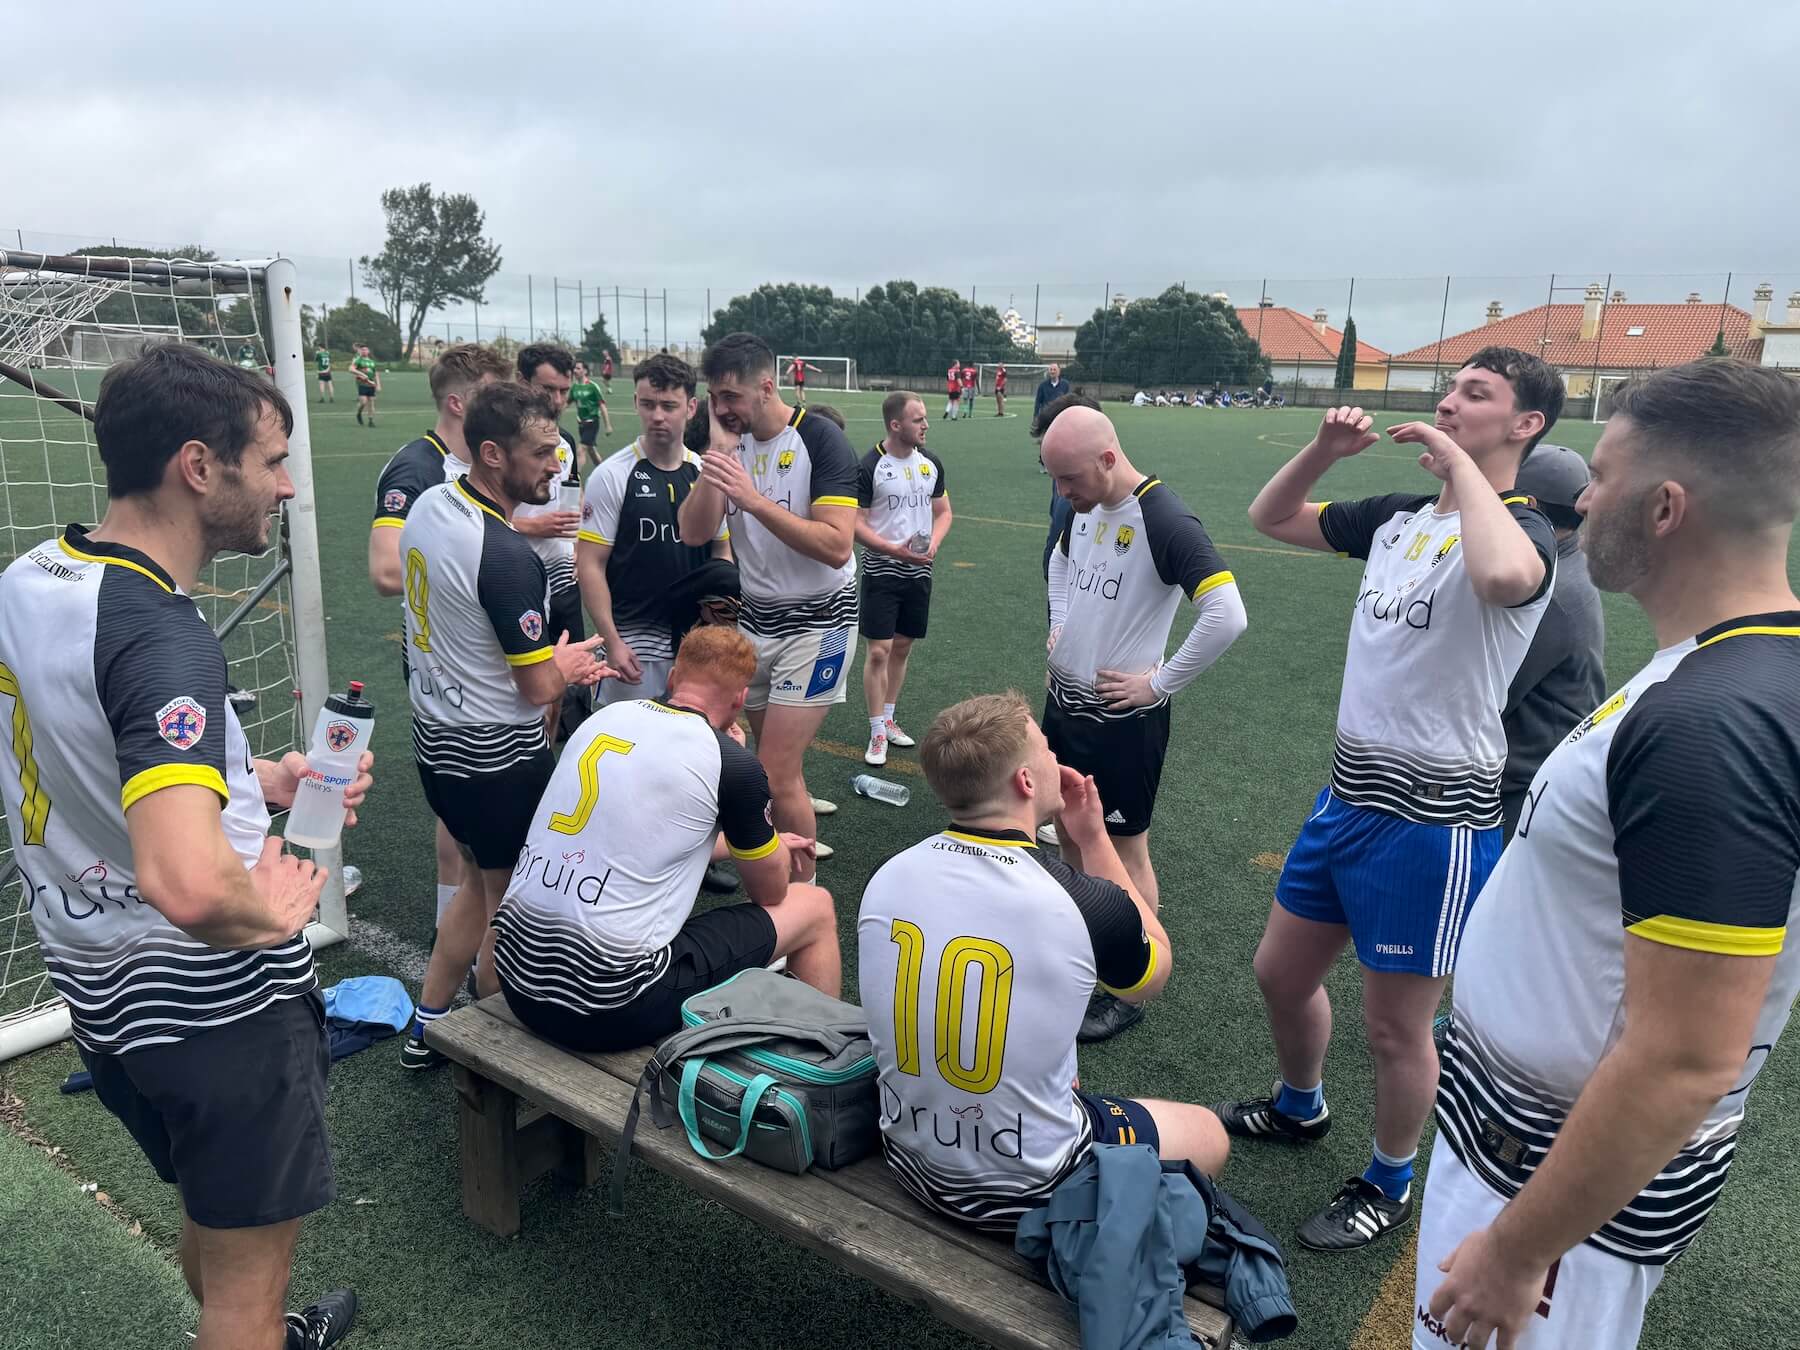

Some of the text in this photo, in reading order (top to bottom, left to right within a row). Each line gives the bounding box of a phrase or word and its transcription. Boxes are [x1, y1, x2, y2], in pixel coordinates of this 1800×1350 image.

[667, 483, 675, 503] 1
[640, 517, 682, 543] Dru
[305, 769, 352, 785] TERSPORT
[547, 732, 636, 836] 5
[948, 844, 1016, 865] CELTIBEOS
[1375, 943, 1414, 955] O'NEILLS
[890, 918, 1014, 1095] 10
[880, 1080, 1023, 1160] Druid
